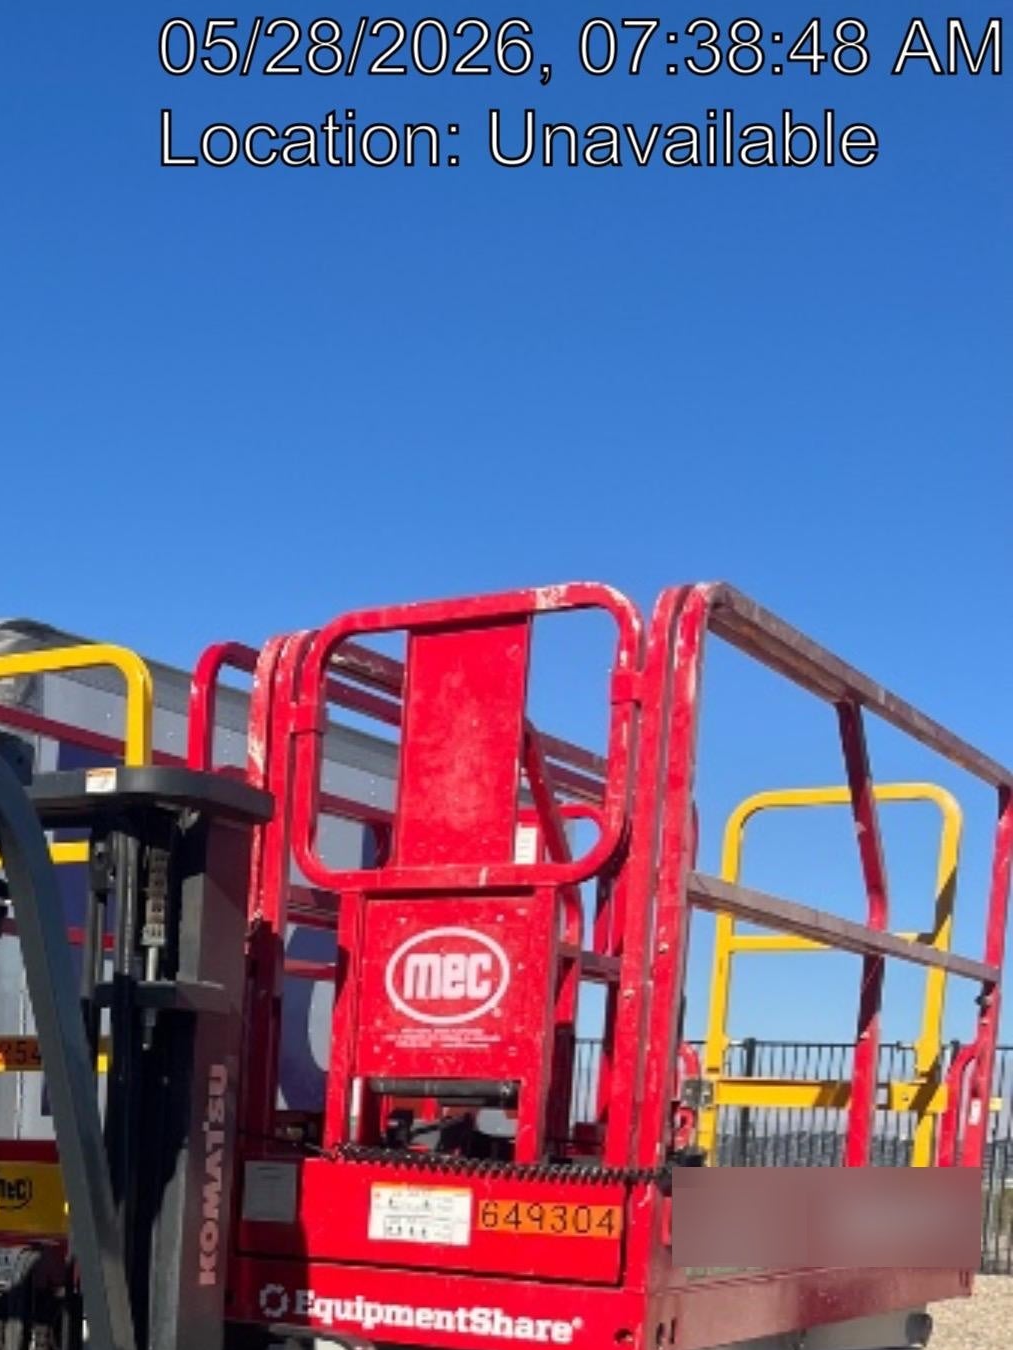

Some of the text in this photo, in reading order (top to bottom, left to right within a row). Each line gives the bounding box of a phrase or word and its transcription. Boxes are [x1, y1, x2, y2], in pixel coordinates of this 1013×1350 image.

[199, 1064, 229, 1285] KOMATSU
[480, 1200, 614, 1237] 649304
[293, 1288, 574, 1344] EquipmentShare
